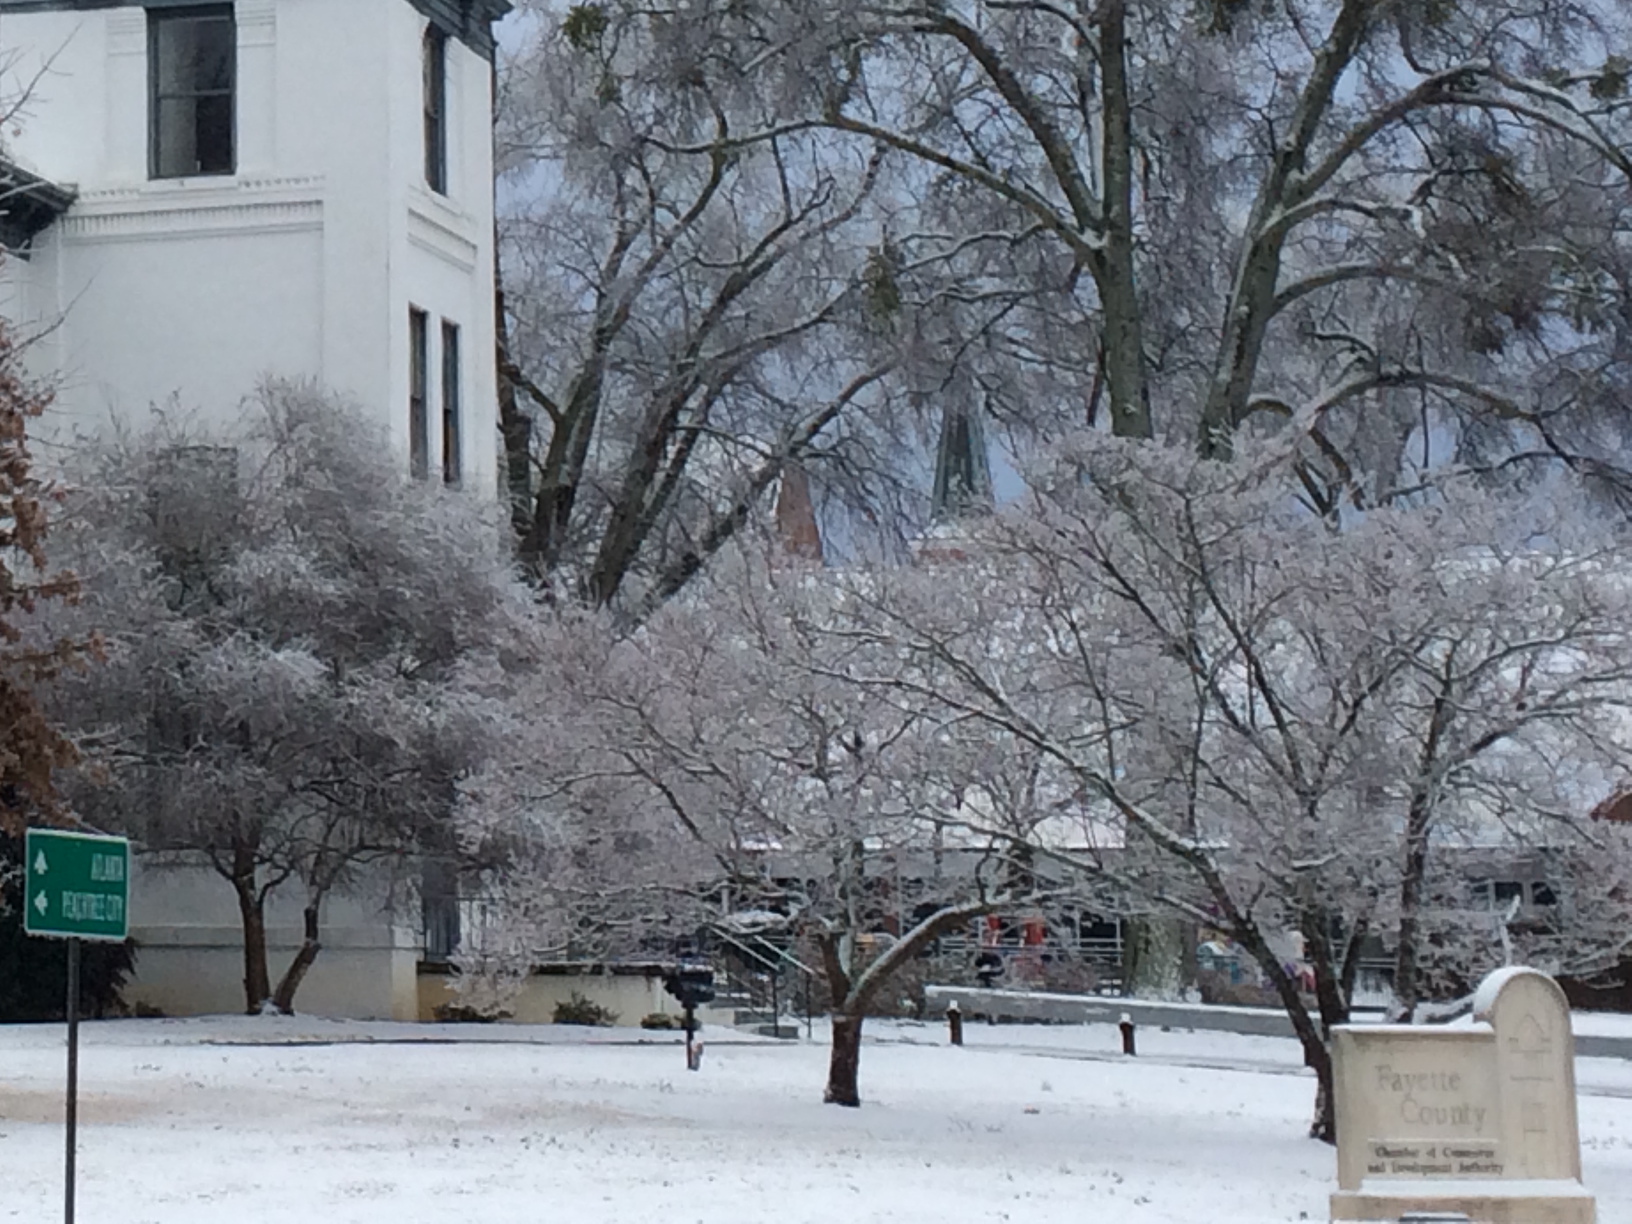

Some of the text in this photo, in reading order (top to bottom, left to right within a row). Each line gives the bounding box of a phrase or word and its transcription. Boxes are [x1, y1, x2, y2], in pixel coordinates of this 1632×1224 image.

[91, 853, 124, 882] ATLANTA
[62, 890, 123, 922] PEACHTREE CITY
[1374, 1063, 1461, 1098] Fayette
[1400, 1096, 1486, 1133] County
[1375, 1146, 1419, 1158] Chamber
[1442, 1146, 1495, 1158] Commerce
[1367, 1160, 1504, 1176] and Development Authority
